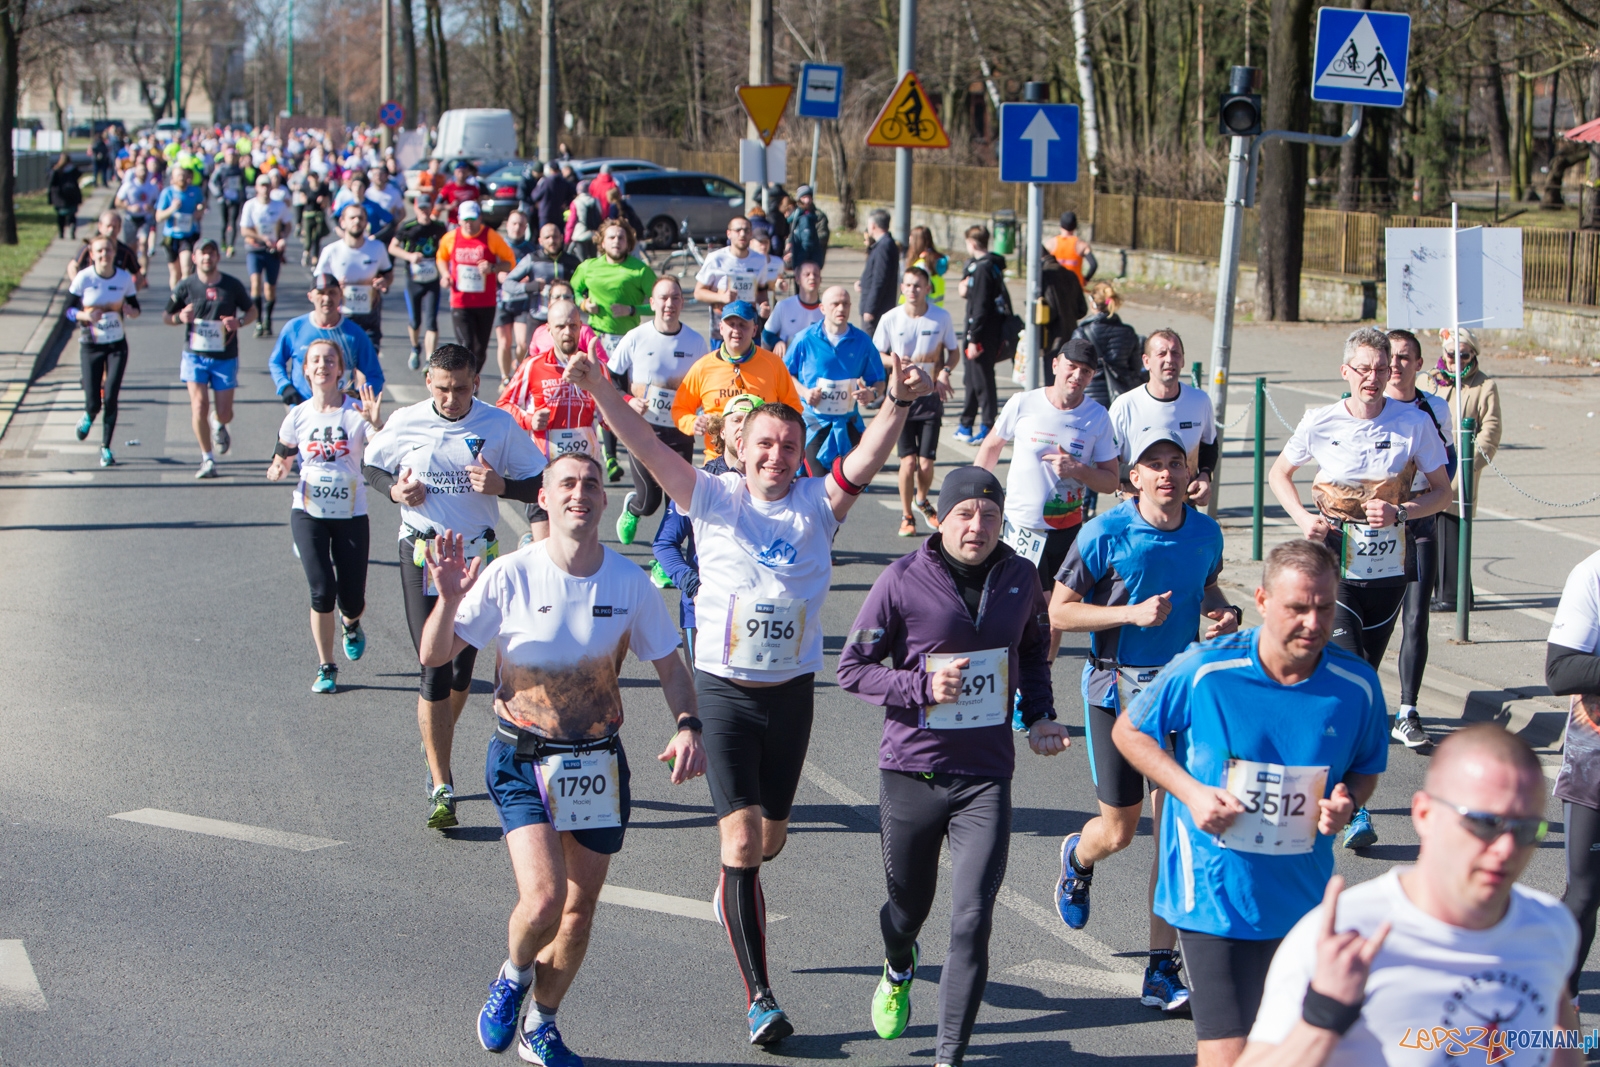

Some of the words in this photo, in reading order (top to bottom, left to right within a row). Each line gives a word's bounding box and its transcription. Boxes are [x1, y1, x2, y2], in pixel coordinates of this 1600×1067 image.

[719, 389, 744, 398] RUN
[821, 390, 848, 401] 5470
[652, 398, 672, 411] 104
[556, 439, 589, 454] 5699
[432, 477, 470, 485] WALKA
[312, 485, 349, 500] 3945
[425, 485, 475, 495] KOSTRZY
[1016, 528, 1032, 556] 263
[1356, 539, 1397, 557] 2297
[537, 605, 553, 614] 4F
[746, 618, 795, 640] 9156
[961, 673, 995, 697] 491
[955, 698, 984, 706] Krzysztof
[557, 774, 607, 798] 1790
[1244, 789, 1307, 817] 3512
